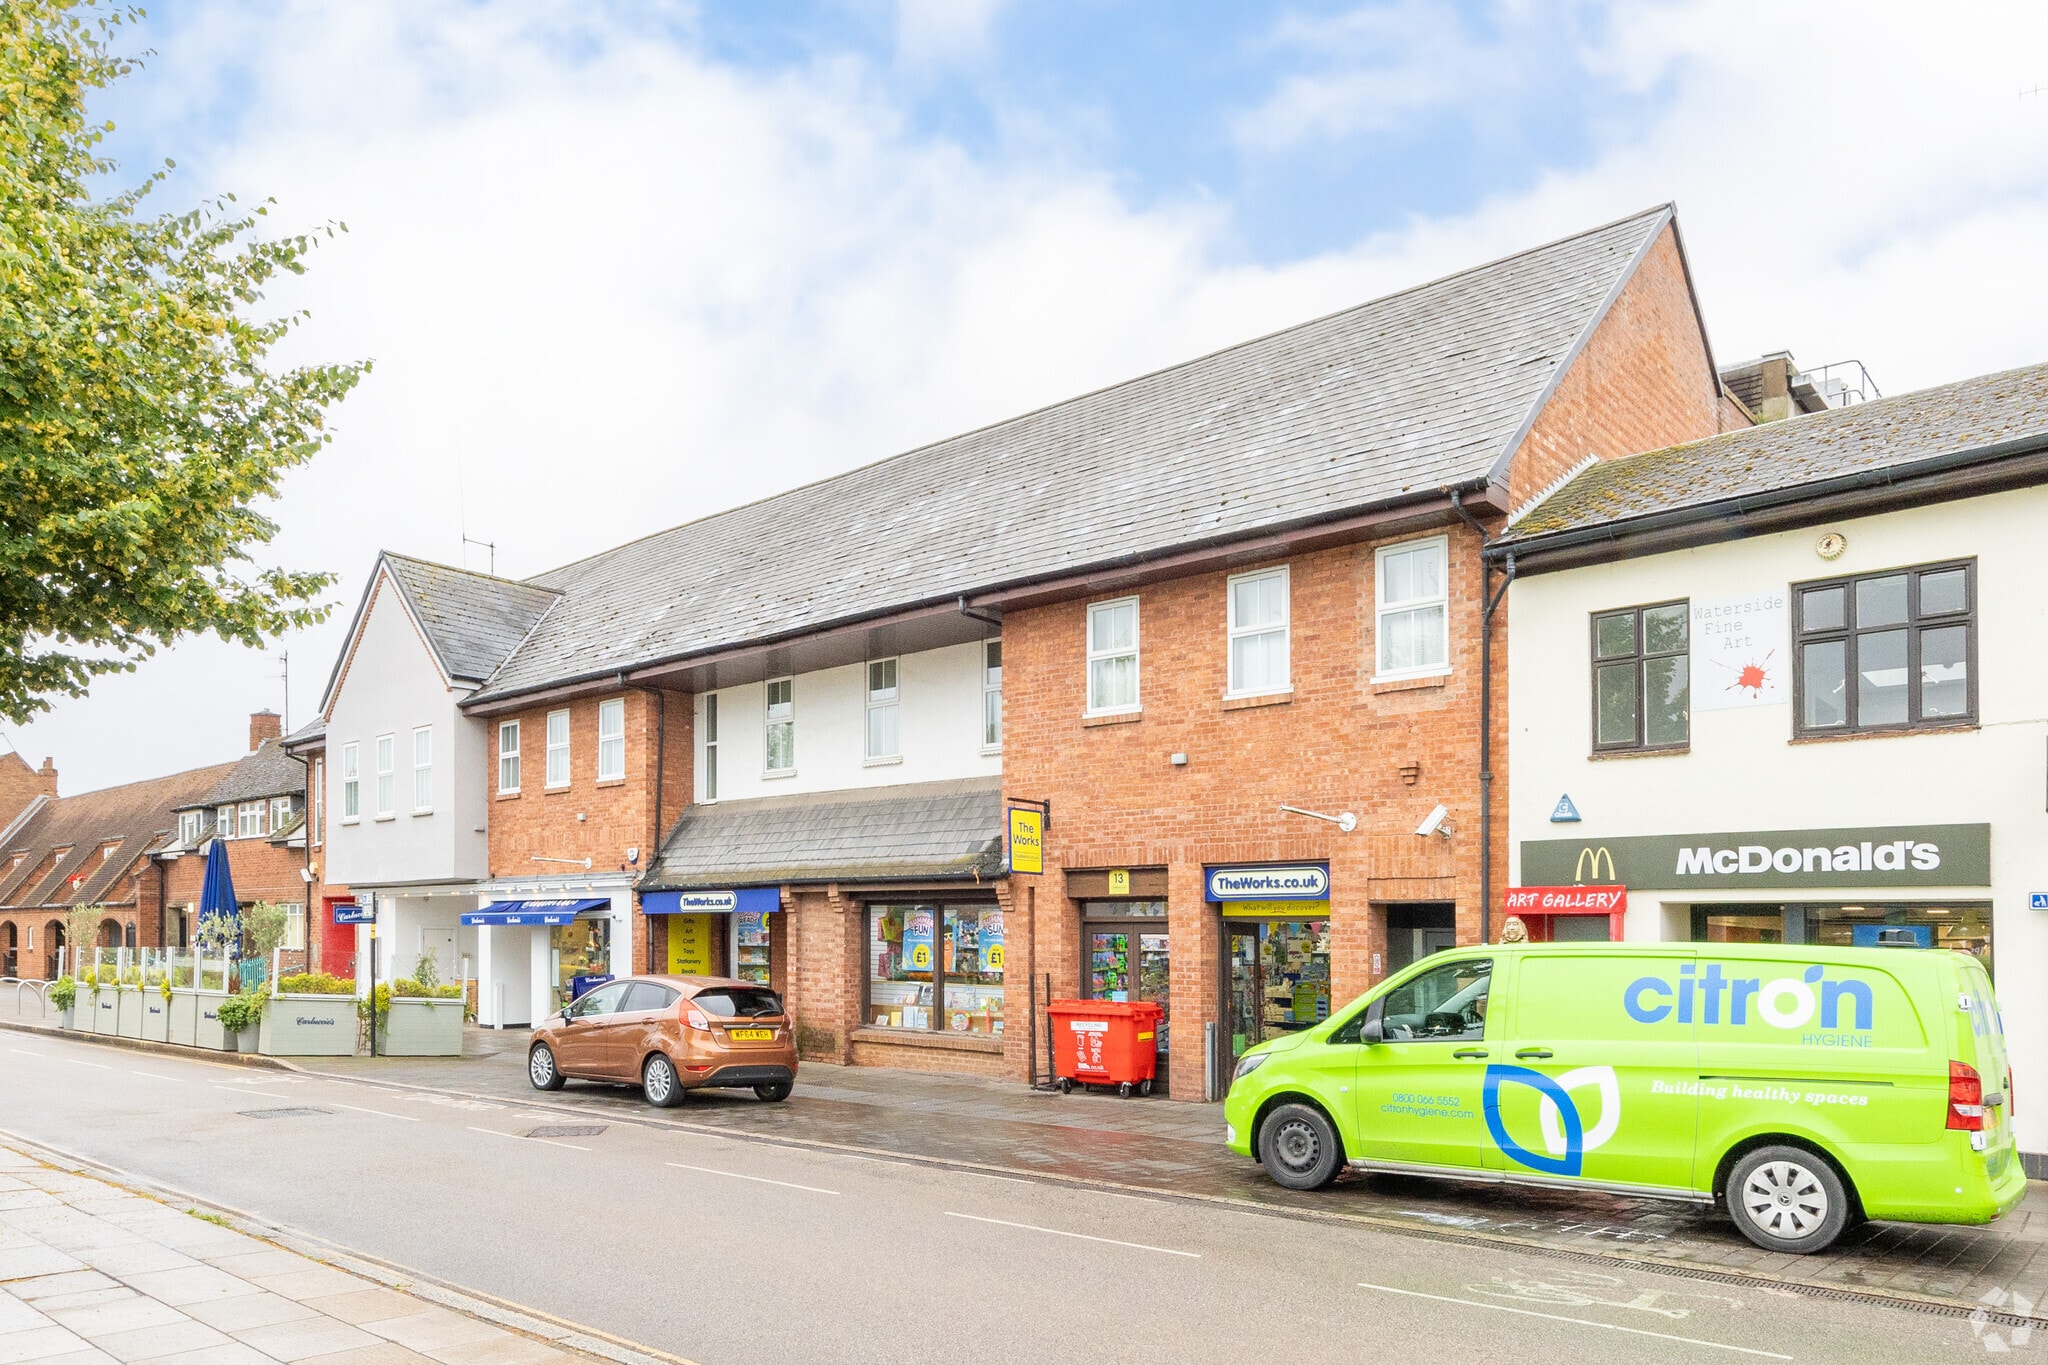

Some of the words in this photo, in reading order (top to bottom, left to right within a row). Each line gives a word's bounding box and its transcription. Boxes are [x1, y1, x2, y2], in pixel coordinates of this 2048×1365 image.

[1693, 596, 1783, 620] Waterside
[1705, 621, 1743, 635] Fine
[1723, 635, 1753, 650] Art
[1018, 822, 1034, 834] The
[1013, 834, 1040, 847] Works
[1675, 840, 1941, 875] McDonald's
[1114, 873, 1124, 883] 13
[1217, 874, 1319, 890] TheWorks.co.uk
[682, 896, 732, 907] TheWorks.co.uk
[1242, 902, 1260, 911] What
[1273, 904, 1286, 912] you
[1286, 901, 1320, 911] discover?
[1506, 892, 1540, 908] ART
[1542, 891, 1622, 908] GALLERY
[914, 924, 929, 936] FUN
[916, 951, 927, 963] £1
[991, 952, 1002, 963] £1
[1802, 1033, 1873, 1048] HYGIENE
[1651, 1079, 1728, 1100] Building
[1732, 1084, 1801, 1105] healthy
[1804, 1091, 1868, 1106] spaces
[1392, 1093, 1415, 1103] 0800
[1417, 1094, 1435, 1105] 066
[1437, 1096, 1460, 1107] 5552
[1380, 1103, 1474, 1119] citronhygiene.com
